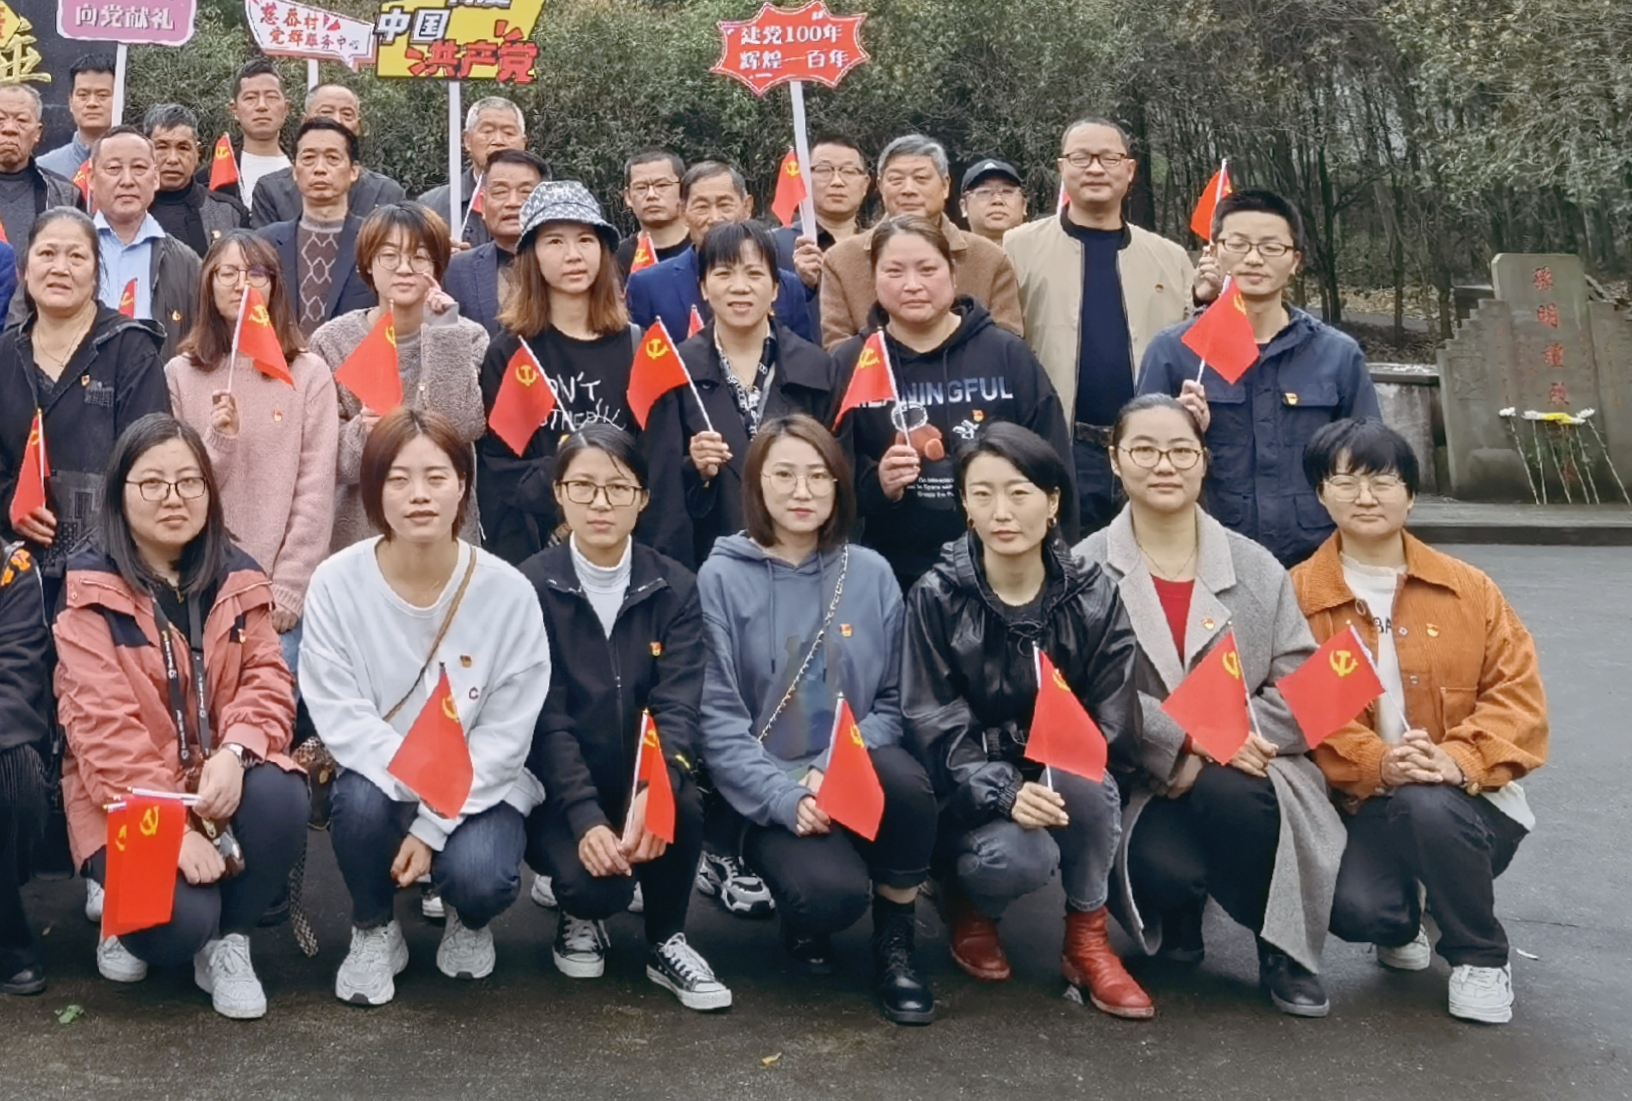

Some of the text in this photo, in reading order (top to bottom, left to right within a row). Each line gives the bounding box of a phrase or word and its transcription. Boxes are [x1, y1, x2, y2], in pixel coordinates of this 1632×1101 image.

[74, 3, 175, 31] 向党献礼
[376, 6, 451, 43] 中国
[740, 23, 844, 46] 建党100年
[424, 38, 538, 84] 共产党
[739, 49, 850, 71] 辉煌一百年
